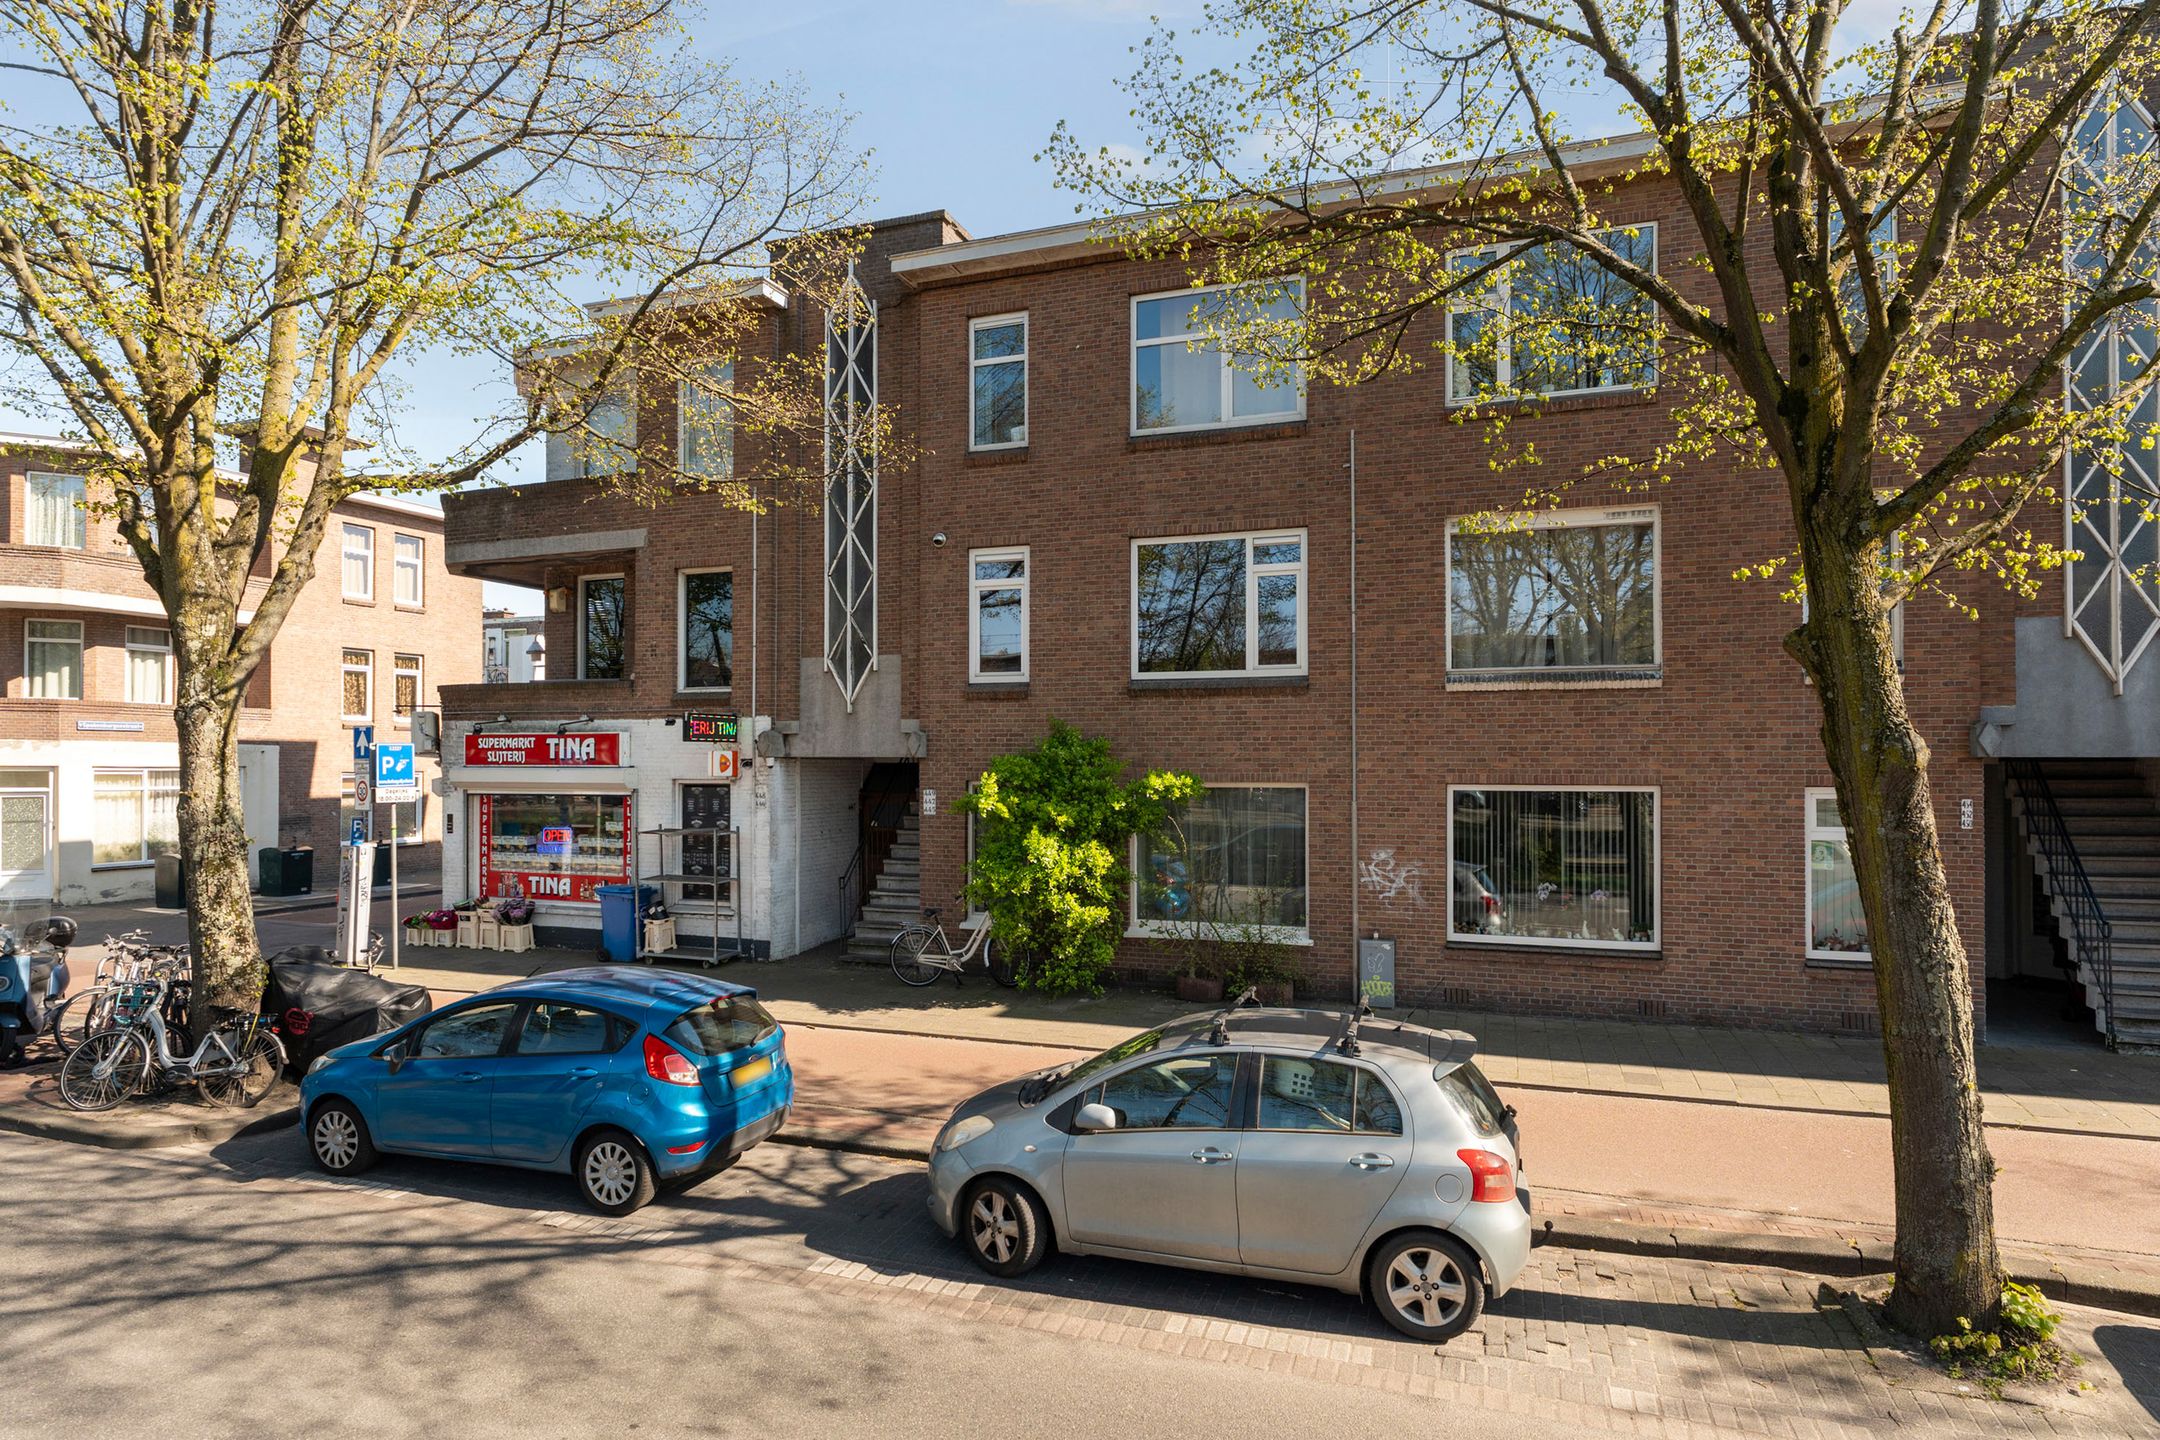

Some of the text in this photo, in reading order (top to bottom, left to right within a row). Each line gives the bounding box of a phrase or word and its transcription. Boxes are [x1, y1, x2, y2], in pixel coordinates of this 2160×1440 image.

[692, 720, 715, 735] ERIJ
[478, 737, 595, 761] SUPERMARKT TINA
[487, 751, 526, 763] SLIJTERIJ
[382, 756, 394, 775] P
[544, 829, 571, 842] OPEN
[528, 876, 572, 897] TINA
